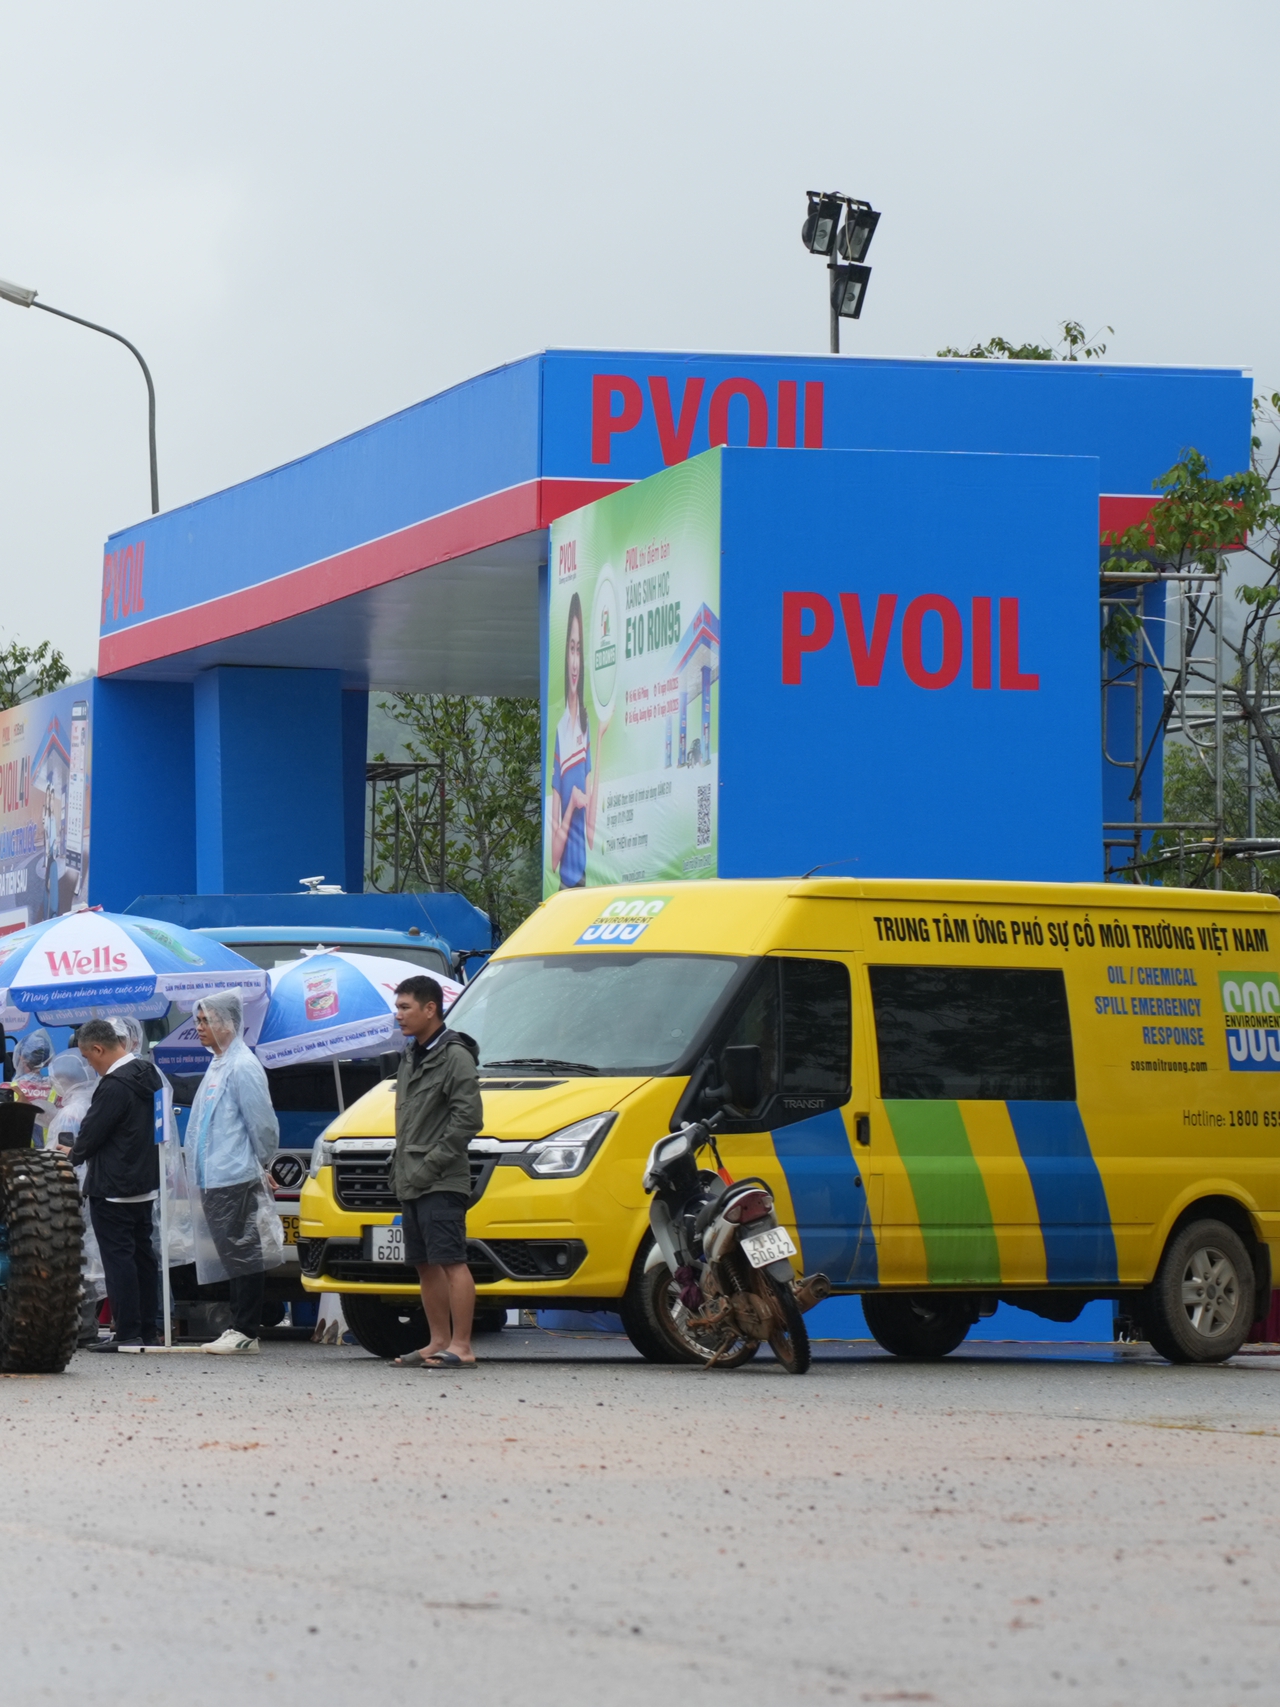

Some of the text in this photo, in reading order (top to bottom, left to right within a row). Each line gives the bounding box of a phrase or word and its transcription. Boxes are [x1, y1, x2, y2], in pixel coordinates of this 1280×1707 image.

[559, 540, 577, 576] PVOIL
[101, 541, 145, 625] PVOIL
[626, 579, 641, 610] XĂNG
[643, 576, 657, 604] SINH
[625, 613, 644, 659] E10
[647, 601, 680, 652] RON95
[781, 591, 1039, 691] PVOIL
[593, 916, 654, 924] ENVIRONMENT
[874, 913, 1269, 956] TRUNG TÂM ỨNG PHÓ SỰ CỐ MÔI TRƯỜNG VIỆT NAM
[44, 946, 128, 977] Wells
[1108, 966, 1197, 986] OIL / CHEMICAL
[21, 990, 49, 1004] Mang
[1095, 996, 1202, 1017] SPILL EMERGENCY
[1225, 1015, 1280, 1028] ENVIRONMEN
[1142, 1026, 1205, 1046] RESPONSE
[1130, 1058, 1207, 1073] sosmoitruong.com
[21, 1088, 48, 1097] PVOIL
[783, 1099, 825, 1108] TRANSIT
[1183, 1109, 1226, 1127] Hotline:
[1229, 1110, 1258, 1127] 1800
[282, 1217, 299, 1229] 5C
[387, 1229, 402, 1244] 30
[378, 1246, 403, 1261] 620.
